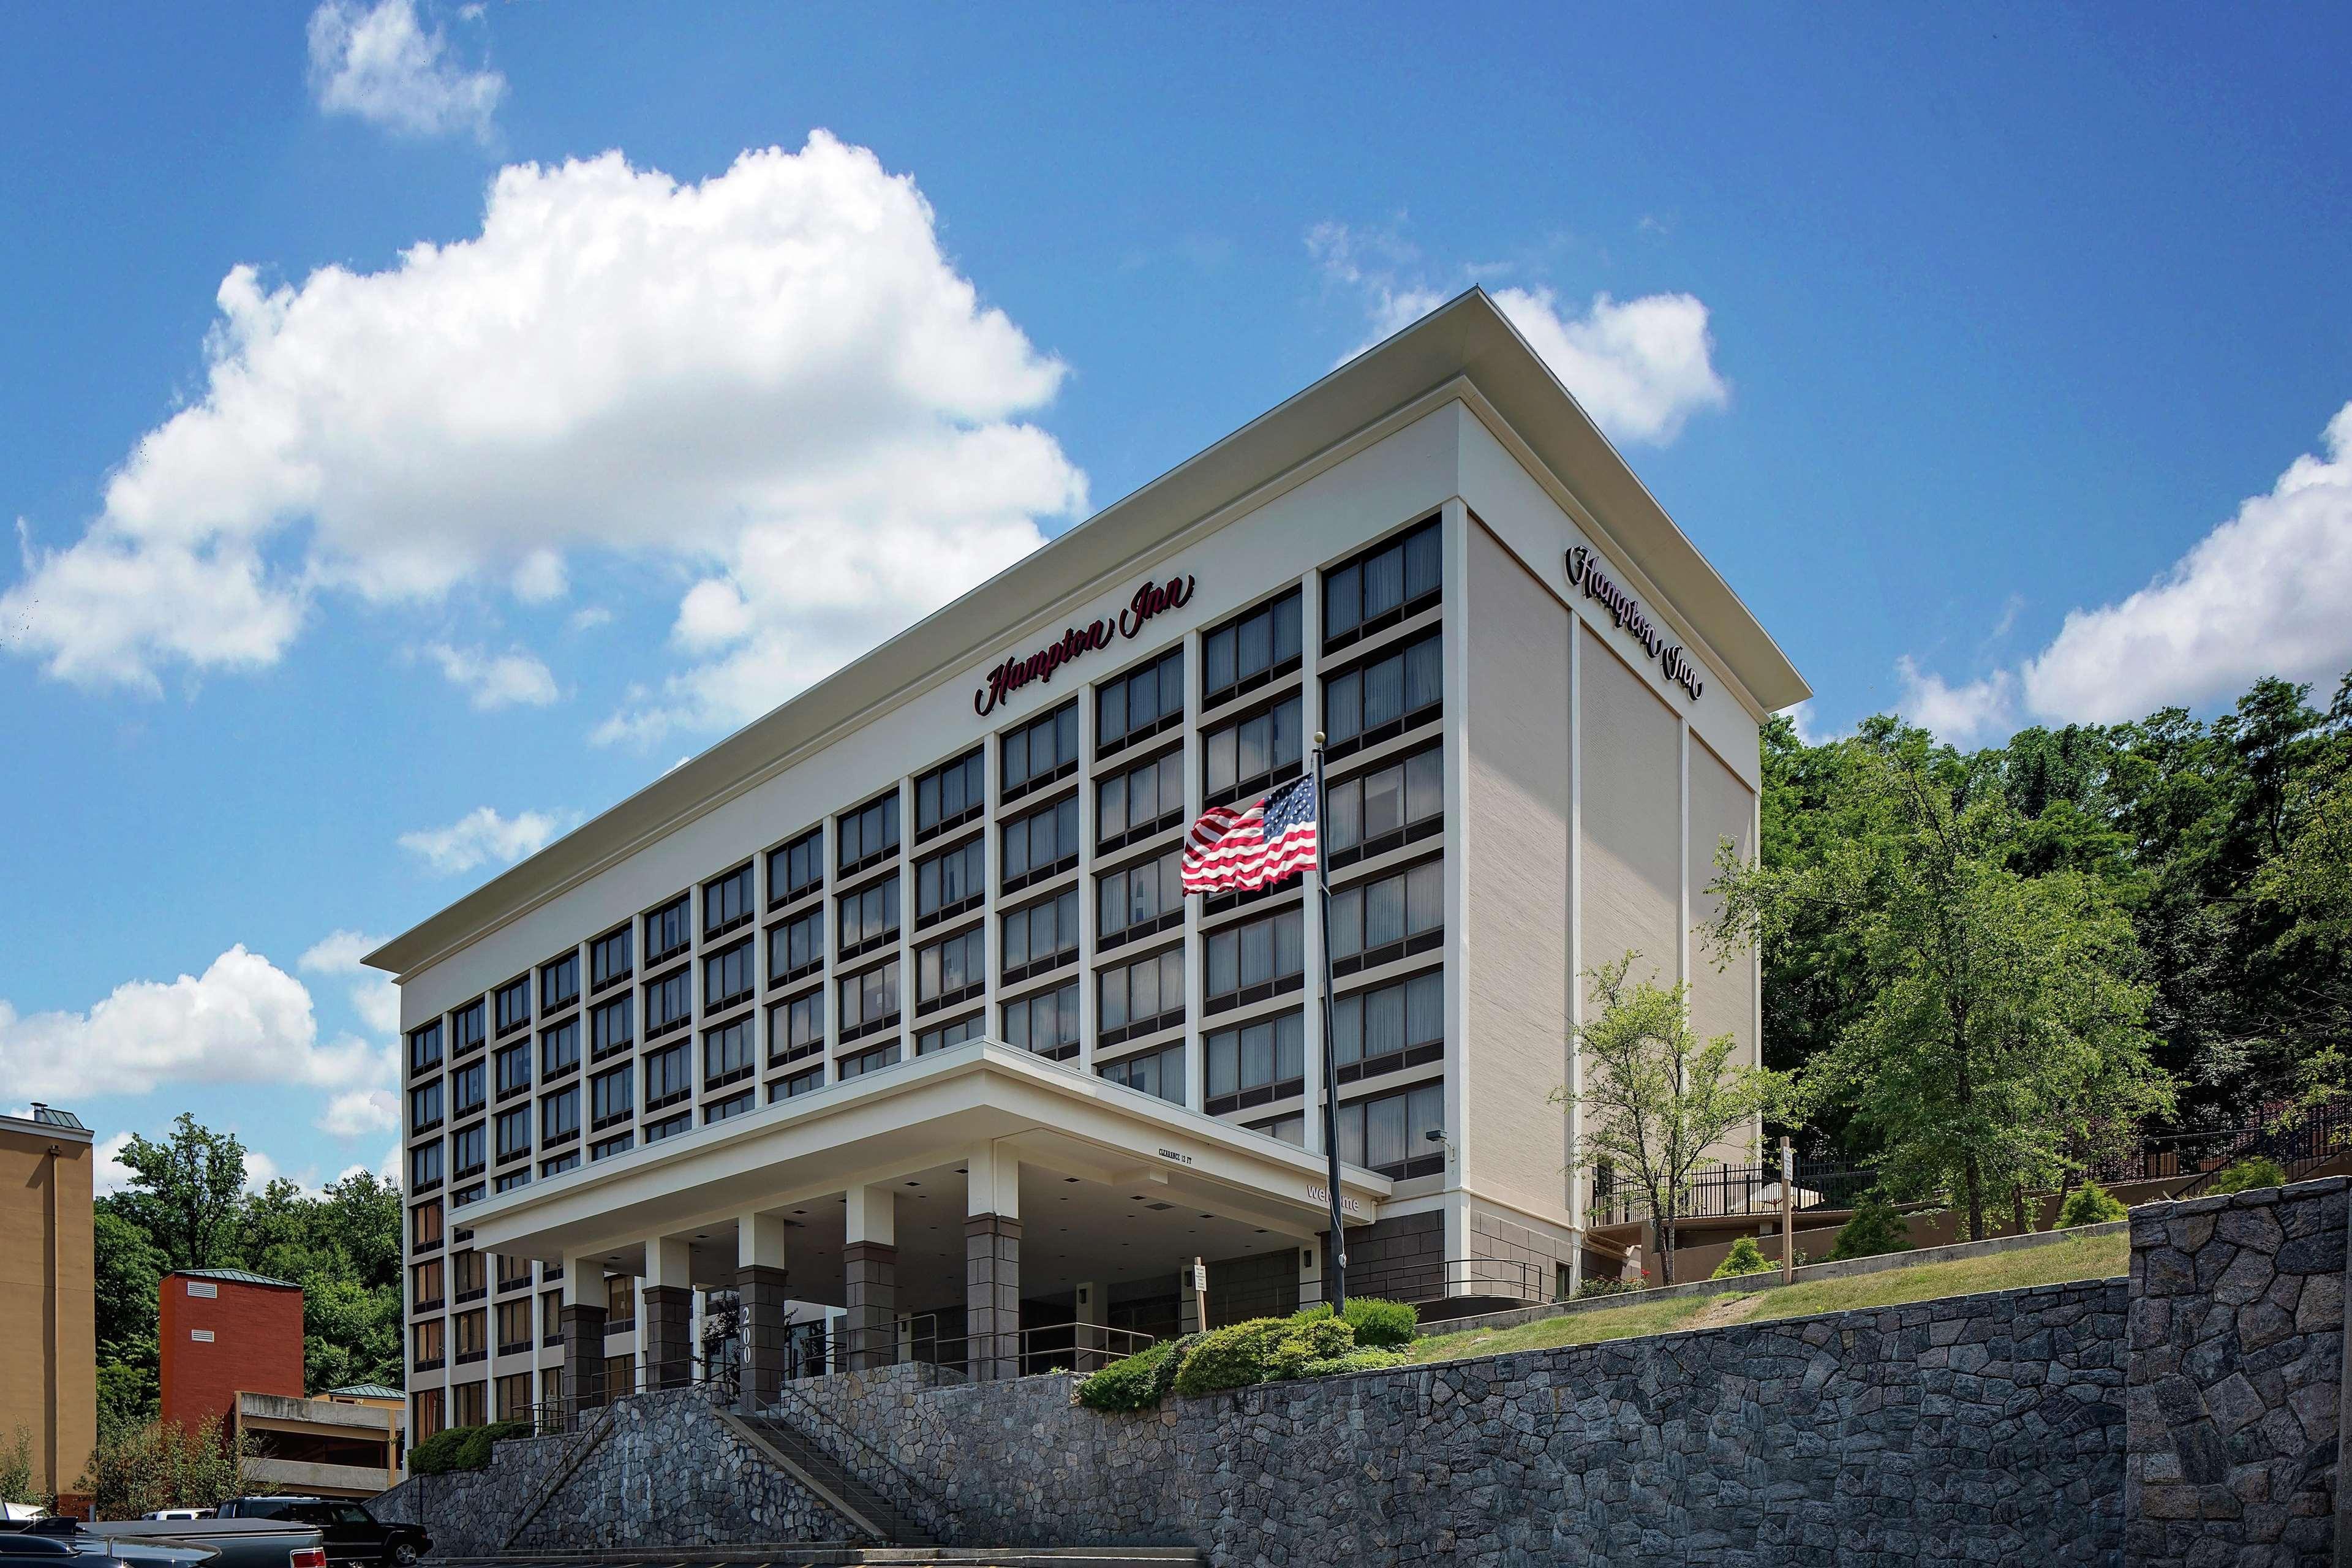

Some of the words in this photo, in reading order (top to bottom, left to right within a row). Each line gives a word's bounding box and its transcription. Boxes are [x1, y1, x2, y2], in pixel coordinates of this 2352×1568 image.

[974, 617, 1115, 717] Hampton
[1119, 574, 1196, 639] Inn
[1564, 546, 1663, 658] Hampton
[1660, 645, 1704, 701] Inn
[1159, 1148, 1180, 1161] CLEARANCE
[1307, 1185, 1359, 1212] welme
